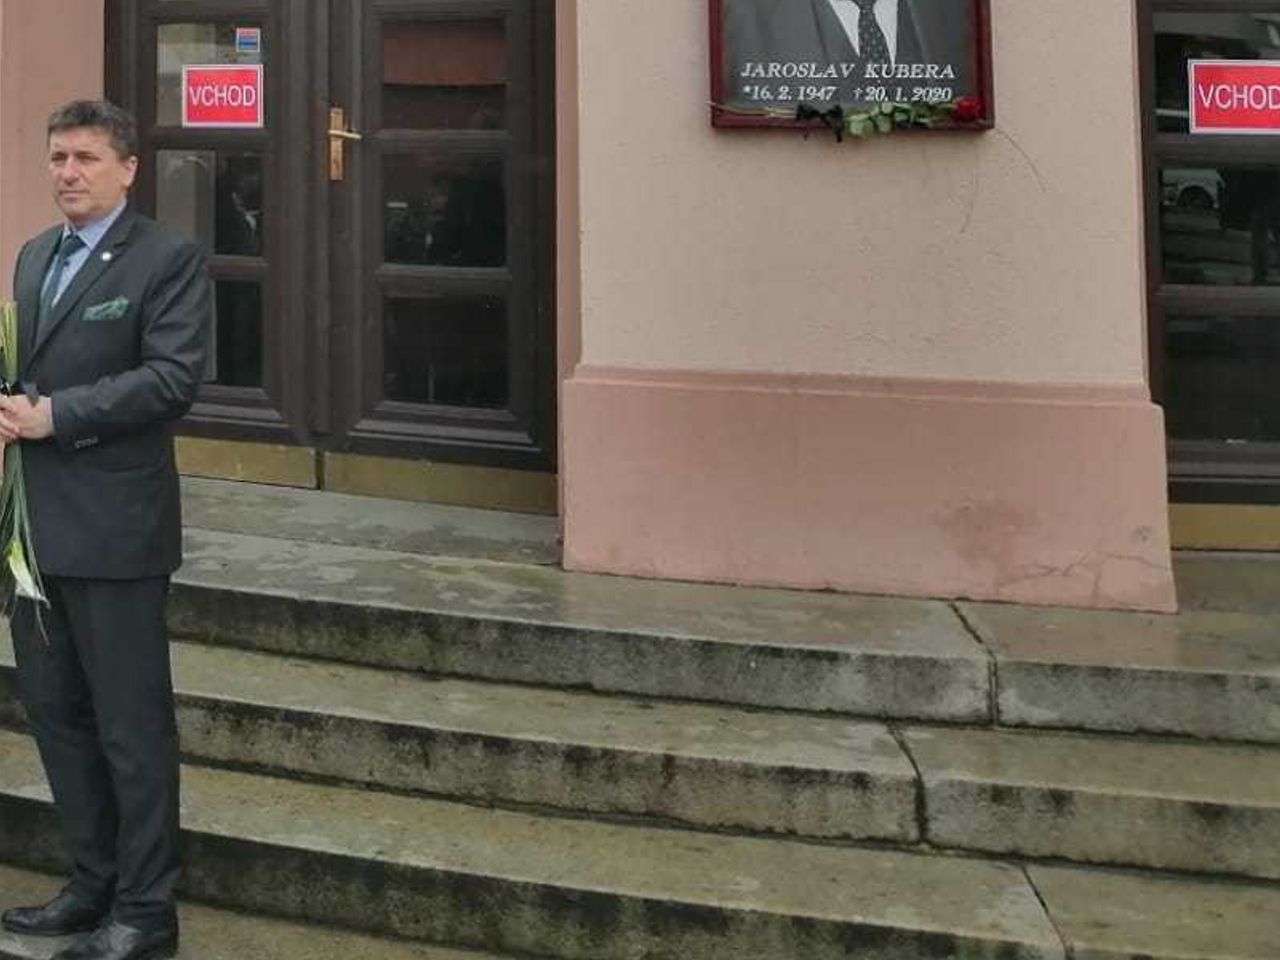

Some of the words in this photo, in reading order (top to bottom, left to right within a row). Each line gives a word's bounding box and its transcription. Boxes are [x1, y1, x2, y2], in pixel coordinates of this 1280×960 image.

[740, 62, 855, 79] JAROSLAV
[864, 62, 956, 79] KUBERA
[187, 85, 257, 107] VCHOD
[777, 86, 793, 101] 2.
[799, 85, 838, 101] 1947
[895, 87, 908, 102] 1.
[911, 86, 953, 102] 2020
[1198, 83, 1280, 109] VCHOD
